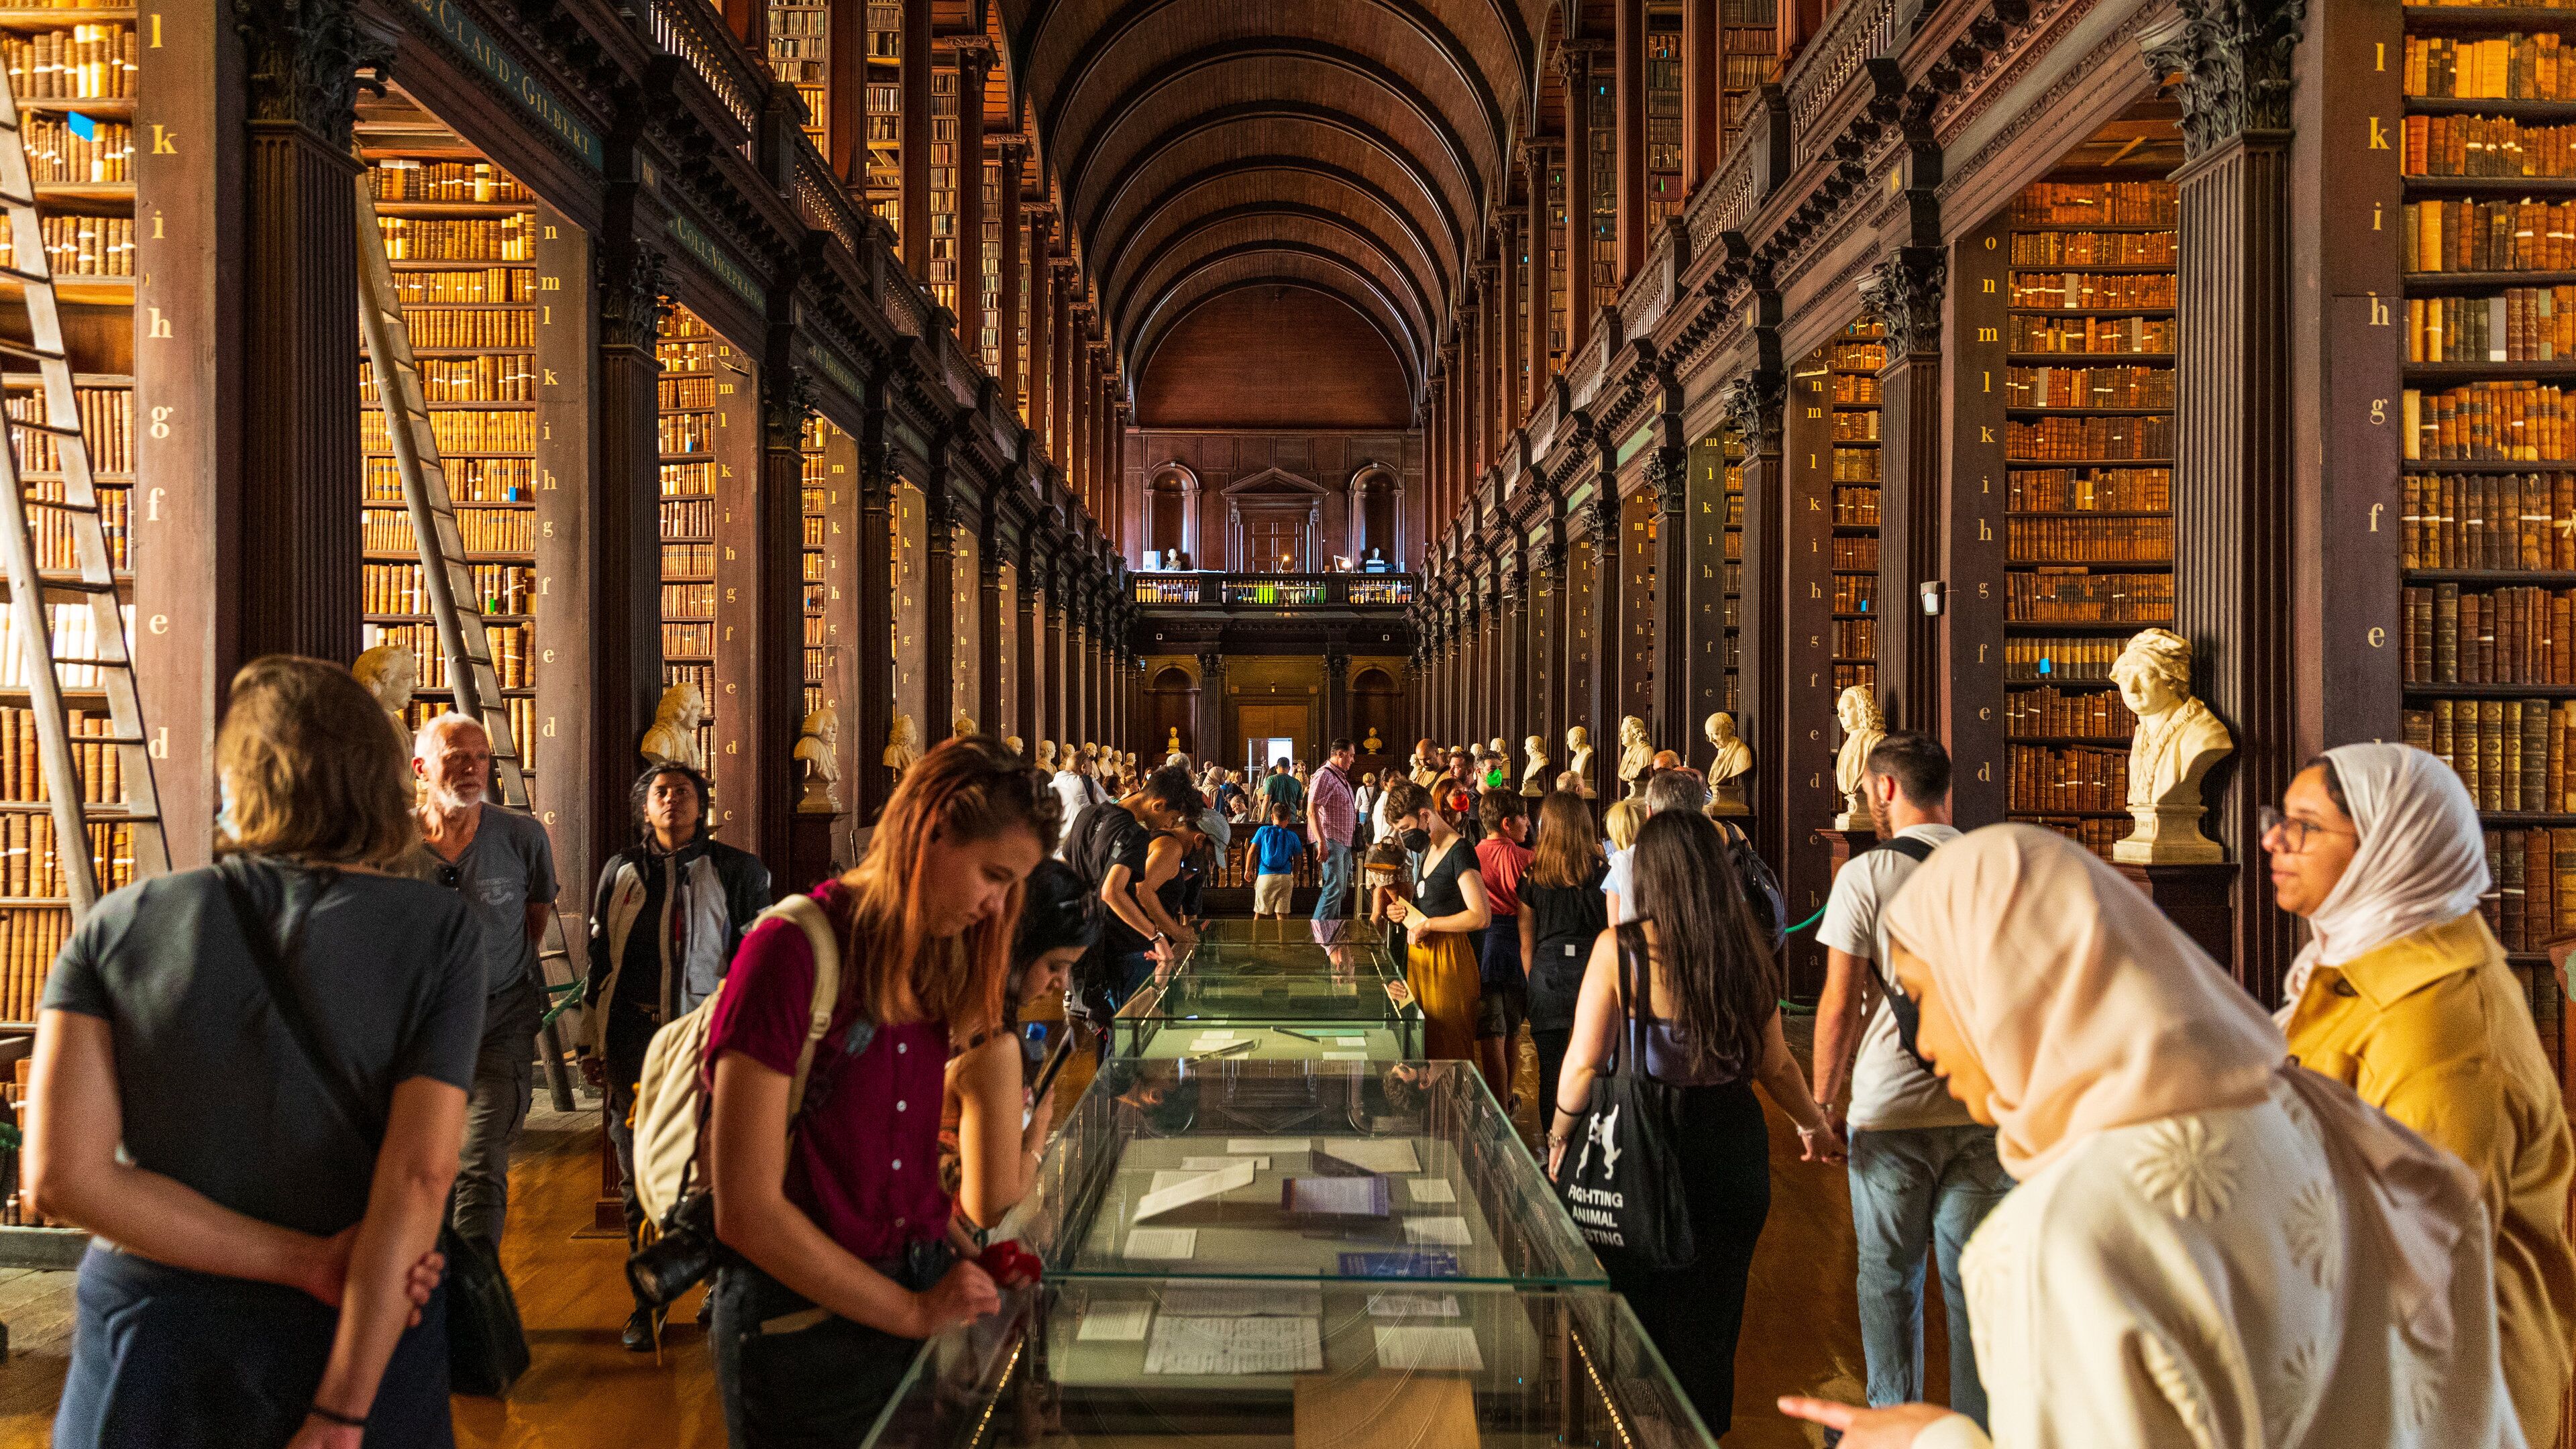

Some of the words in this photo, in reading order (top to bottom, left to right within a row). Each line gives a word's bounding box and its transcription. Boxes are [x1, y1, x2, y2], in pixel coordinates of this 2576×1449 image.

[150, 13, 163, 48] l
[2375, 42, 2385, 72] l
[522, 76, 590, 155] GILBERT
[152, 124, 178, 154] k
[2369, 117, 2390, 150] k
[2373, 201, 2382, 231] i
[150, 210, 165, 239] i
[543, 225, 558, 239] n
[1984, 237, 1997, 250] o
[540, 276, 560, 290] m
[1982, 278, 1996, 293] n
[543, 306, 551, 325] l
[2367, 291, 2390, 326] h
[144, 307, 173, 342] h
[1978, 327, 1998, 342] m
[719, 345, 730, 357] n
[543, 368, 559, 385] k
[1983, 371, 1991, 392] l
[718, 383, 734, 394] m
[1812, 380, 1823, 392] n
[1807, 407, 1822, 419] m
[2369, 398, 2388, 425] g
[149, 406, 174, 439] g
[720, 412, 727, 427] l
[543, 421, 551, 440] i
[1980, 426, 1995, 443] k
[1705, 437, 1718, 447] m
[1811, 453, 1817, 469] l
[721, 464, 733, 478] k
[832, 464, 845, 474] m
[1708, 467, 1713, 480] l
[541, 469, 557, 490] h
[1982, 475, 1989, 494] i
[146, 487, 166, 522] f
[830, 490, 837, 504] l
[1809, 497, 1821, 511] k
[725, 507, 730, 523] i
[1703, 502, 1712, 513] k
[2368, 502, 2384, 532] f
[542, 521, 553, 538] g
[832, 521, 841, 534] k
[1979, 519, 1992, 541] h
[904, 537, 912, 548] k
[1709, 533, 1713, 545] i
[1812, 537, 1818, 553] i
[725, 546, 735, 560] h
[830, 555, 836, 569] i
[1703, 564, 1713, 578] h
[540, 576, 551, 595] f
[830, 586, 840, 600] h
[1811, 582, 1821, 598] h
[1978, 582, 1989, 599] g
[726, 588, 737, 603] g
[903, 595, 912, 606] h
[1704, 604, 1711, 614] g
[148, 614, 168, 635] e
[829, 624, 837, 635] g
[725, 626, 734, 641] f
[903, 635, 911, 647] g
[1811, 635, 1819, 647] g
[2367, 627, 2385, 648] e
[1707, 641, 1713, 653] f
[1978, 643, 1988, 663] f
[543, 649, 555, 663] e
[828, 655, 835, 667] f
[903, 673, 909, 684] f
[1811, 673, 1819, 688] f
[725, 683, 736, 694] e
[1705, 688, 1713, 698] e
[827, 698, 835, 708] e
[1979, 707, 1990, 720] e
[542, 716, 555, 737] d
[1809, 729, 1819, 741] e
[148, 727, 169, 759] d
[725, 740, 737, 755] d
[1977, 761, 1990, 782] d
[1810, 772, 1820, 788] d
[543, 811, 555, 825] c
[723, 810, 732, 820] c
[1809, 835, 1818, 845] c
[1568, 1183, 1623, 1209] FIGHTING
[1572, 1205, 1618, 1228] ANIMAL
